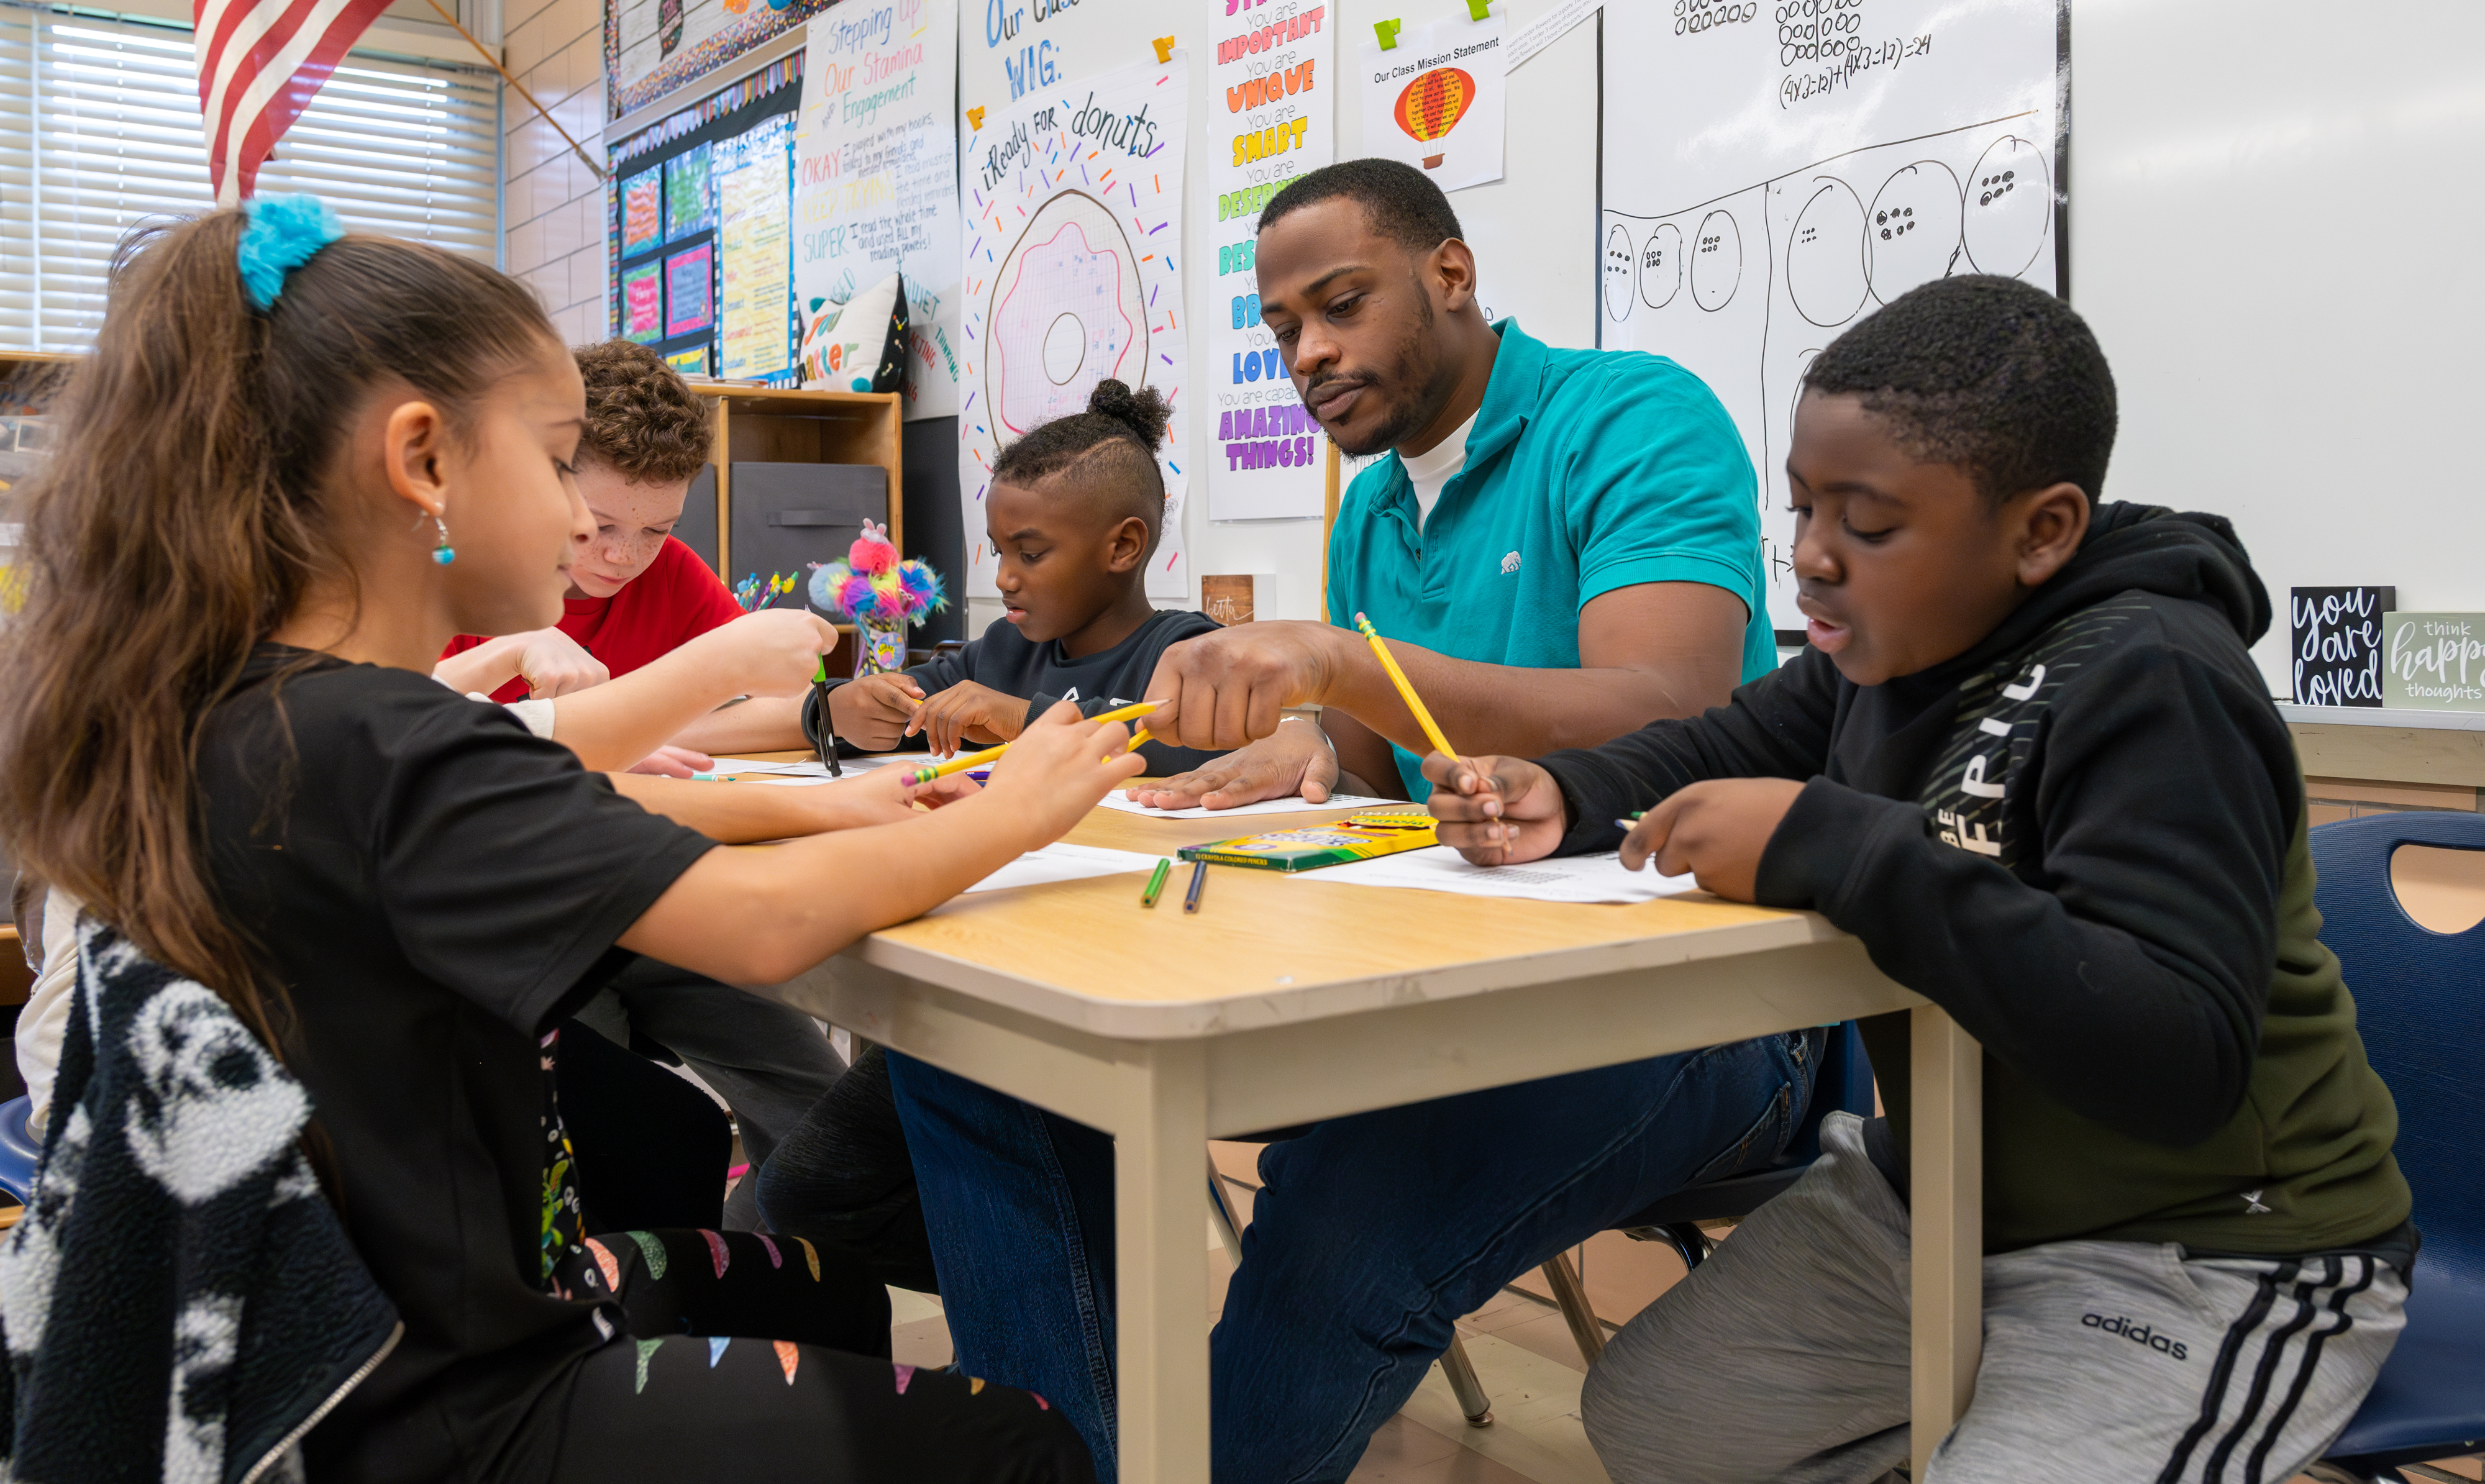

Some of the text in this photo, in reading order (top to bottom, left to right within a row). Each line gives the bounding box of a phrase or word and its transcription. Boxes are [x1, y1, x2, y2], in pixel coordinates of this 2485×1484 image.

[828, 7, 893, 54] Stepping
[1218, 5, 1325, 65] IMPORTANT
[1246, 11, 1272, 30] You
[1275, 1, 1297, 20] are
[1523, 27, 1535, 39] order
[1535, 17, 1552, 30] flowers
[1374, 36, 1500, 84] Our Class Mission Statement
[1507, 48, 1518, 58] each
[1533, 30, 1545, 41] order
[1508, 55, 1520, 66] many
[1520, 44, 1536, 57] flowers
[1547, 30, 1558, 41] have
[824, 43, 924, 97] Our Stamina
[1005, 39, 1062, 102] WIG:
[1246, 51, 1297, 78] You are
[844, 70, 916, 129] Engagement
[1226, 58, 1315, 114] UNIQUE
[1033, 106, 1058, 135] FOR
[1072, 91, 1157, 158] donuts
[1246, 105, 1296, 131] You are
[1233, 116, 1308, 167] SMART
[803, 148, 841, 186] OKAY
[1246, 160, 1294, 185] You are
[803, 170, 895, 224] KEEP TRYING
[849, 204, 937, 239] I read the whole time
[858, 223, 922, 250] and used ALL my
[804, 224, 849, 263] SUPER
[870, 232, 931, 264] reading powers!
[902, 274, 941, 321] QUIET
[804, 309, 844, 346] you
[935, 326, 960, 383] THINKING
[1218, 385, 1300, 406] You are capab
[1226, 436, 1315, 471] THINGS!
[2292, 587, 2375, 662] you
[2322, 621, 2382, 662] are
[2423, 621, 2471, 636] think
[2295, 649, 2382, 706] loved
[2405, 682, 2483, 703] thoughts
[1938, 808, 1961, 849] BE
[2081, 1311, 2187, 1361] adidas
